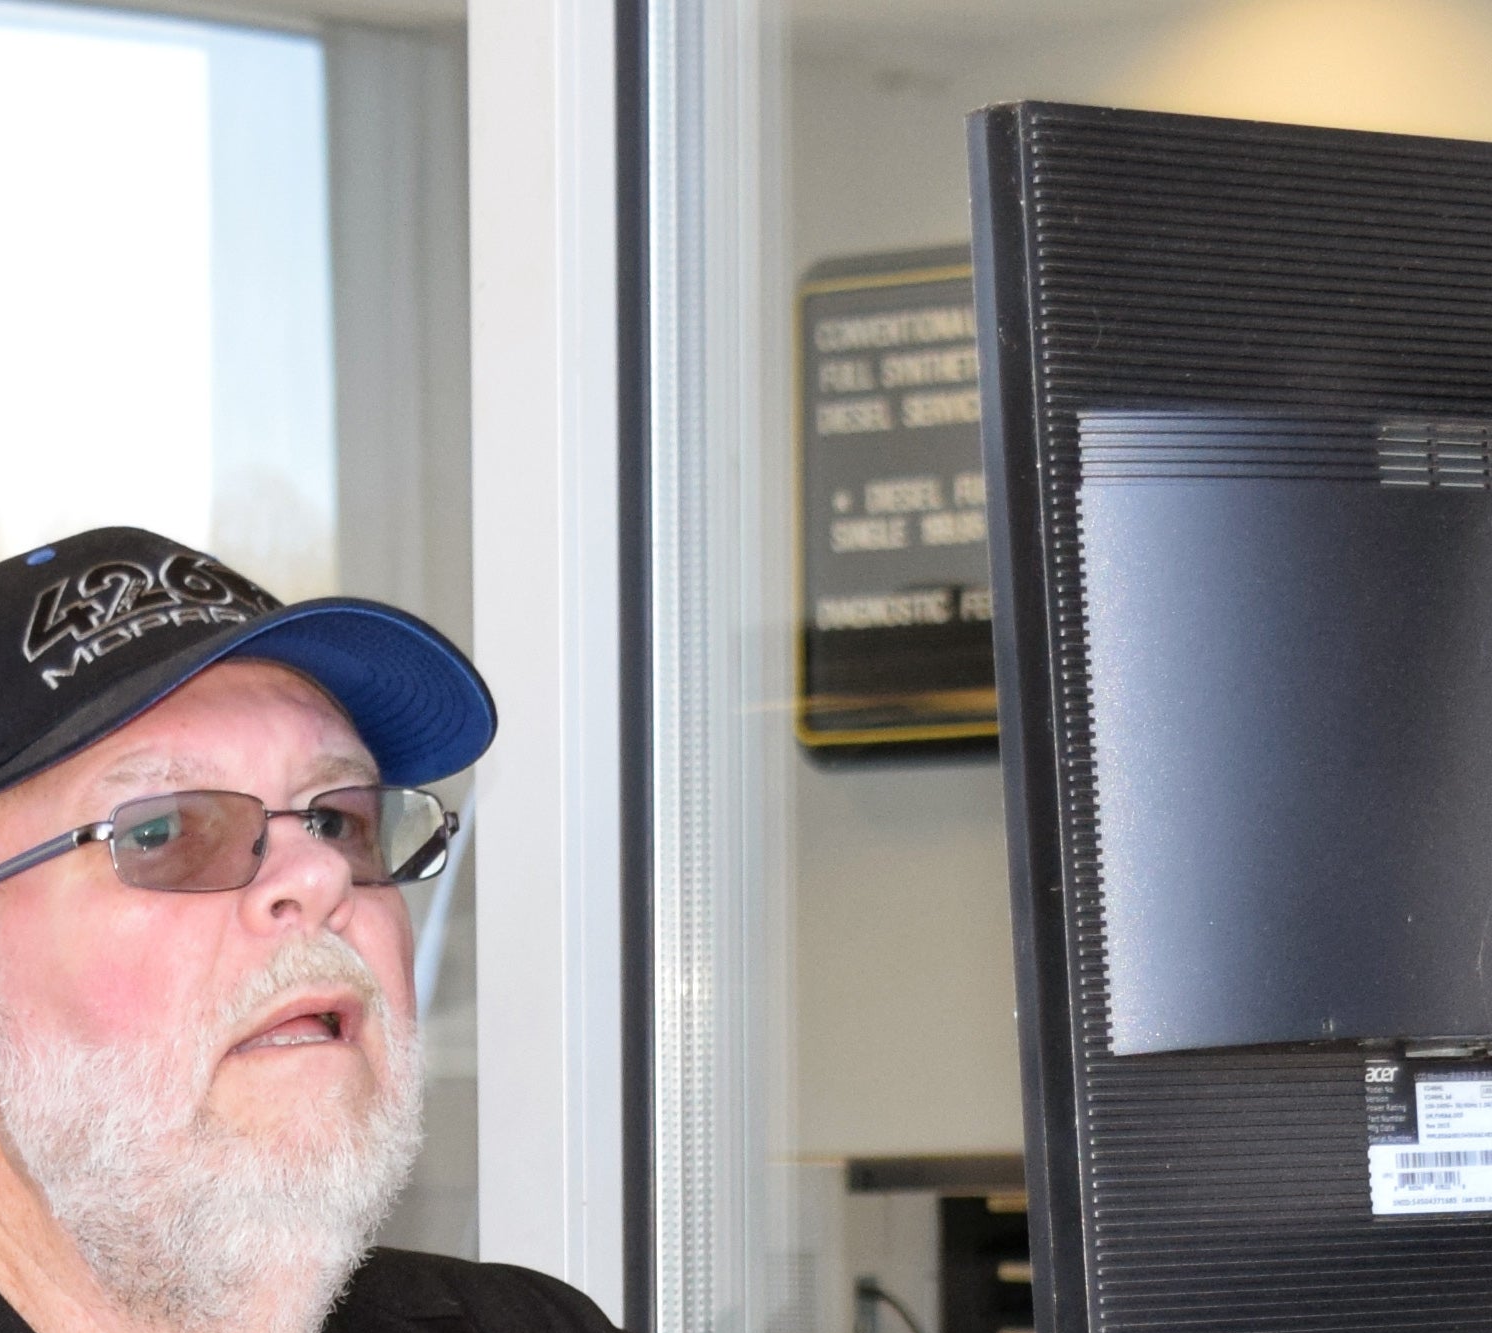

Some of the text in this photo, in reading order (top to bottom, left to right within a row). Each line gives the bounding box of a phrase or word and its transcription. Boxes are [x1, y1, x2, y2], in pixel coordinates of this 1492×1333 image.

[818, 360, 874, 393] FULL
[816, 398, 892, 435] DIESEL
[23, 553, 234, 663] 426
[41, 606, 248, 690] MOPAR
[1365, 1066, 1399, 1083] acer
